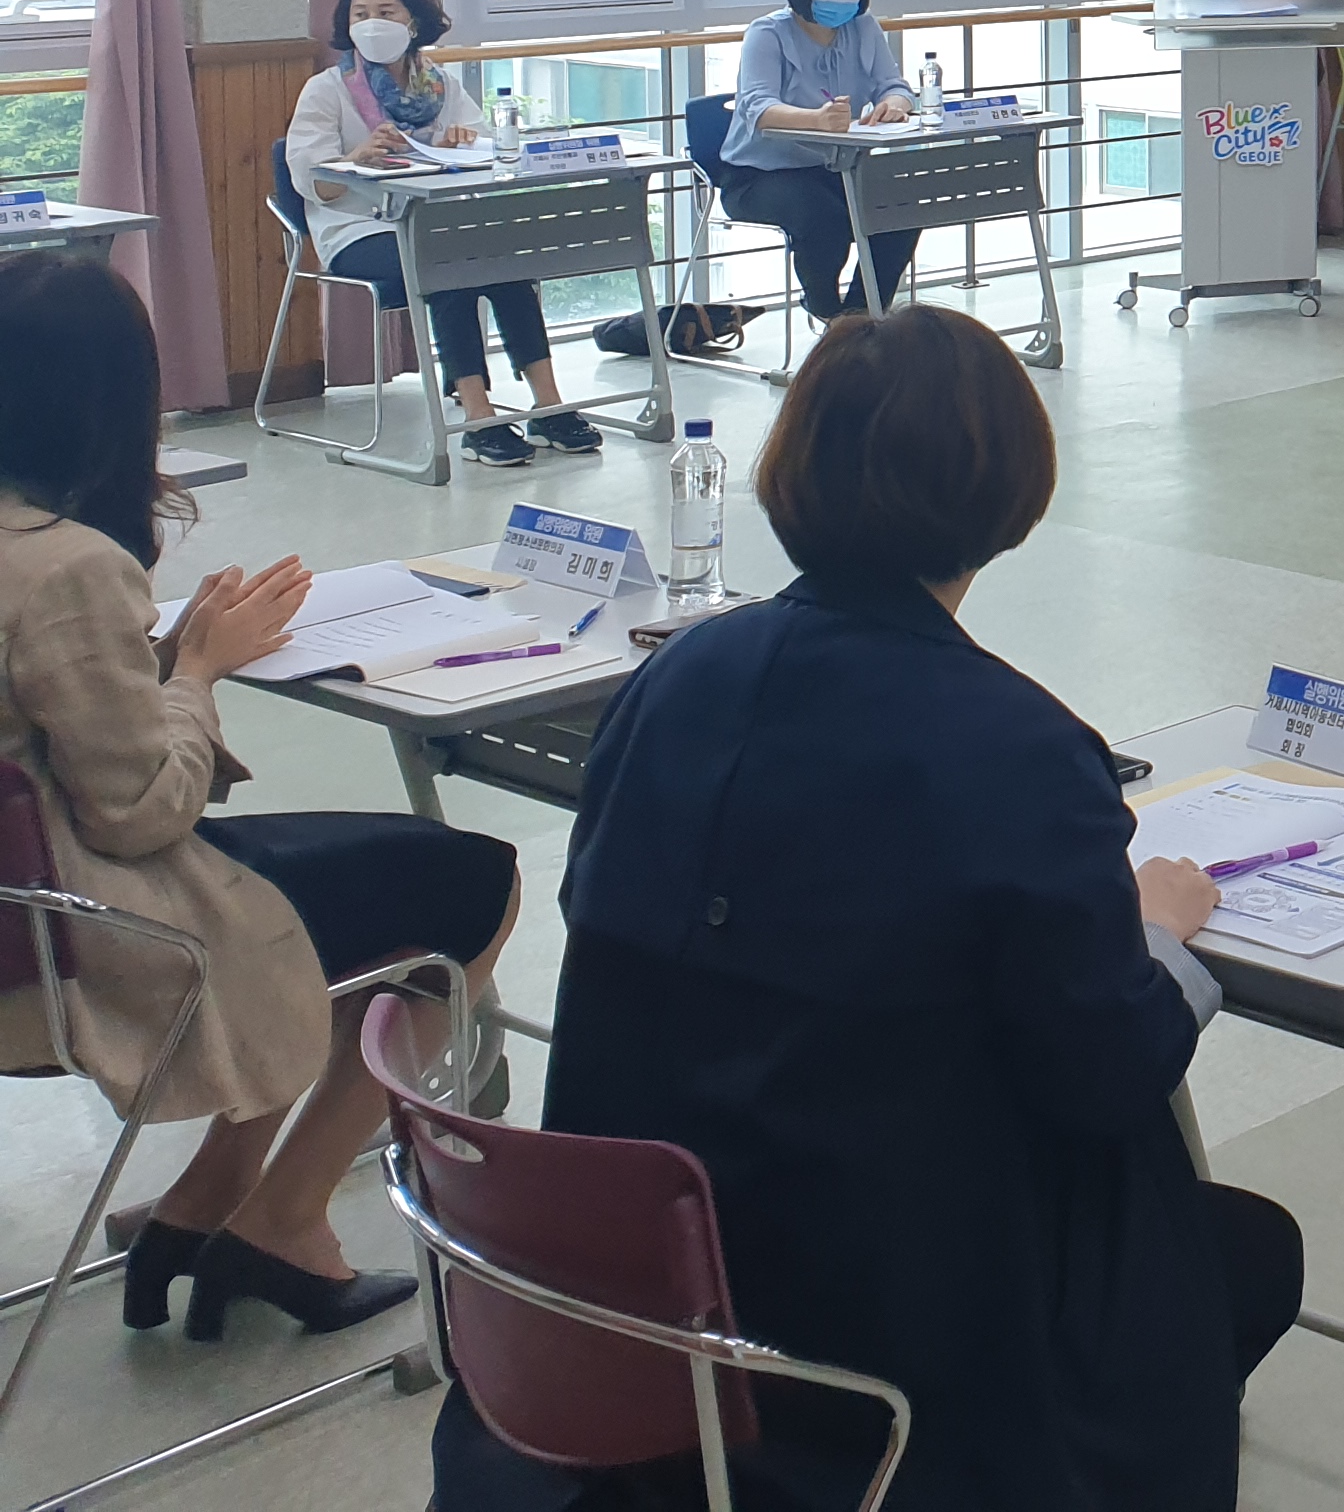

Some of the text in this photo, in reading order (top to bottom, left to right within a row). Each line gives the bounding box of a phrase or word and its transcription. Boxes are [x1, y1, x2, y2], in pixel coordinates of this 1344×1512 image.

[1197, 103, 1266, 136] Blue
[1214, 126, 1266, 158] City
[1238, 151, 1281, 163] GEOJE
[567, 553, 614, 582] 김미희
